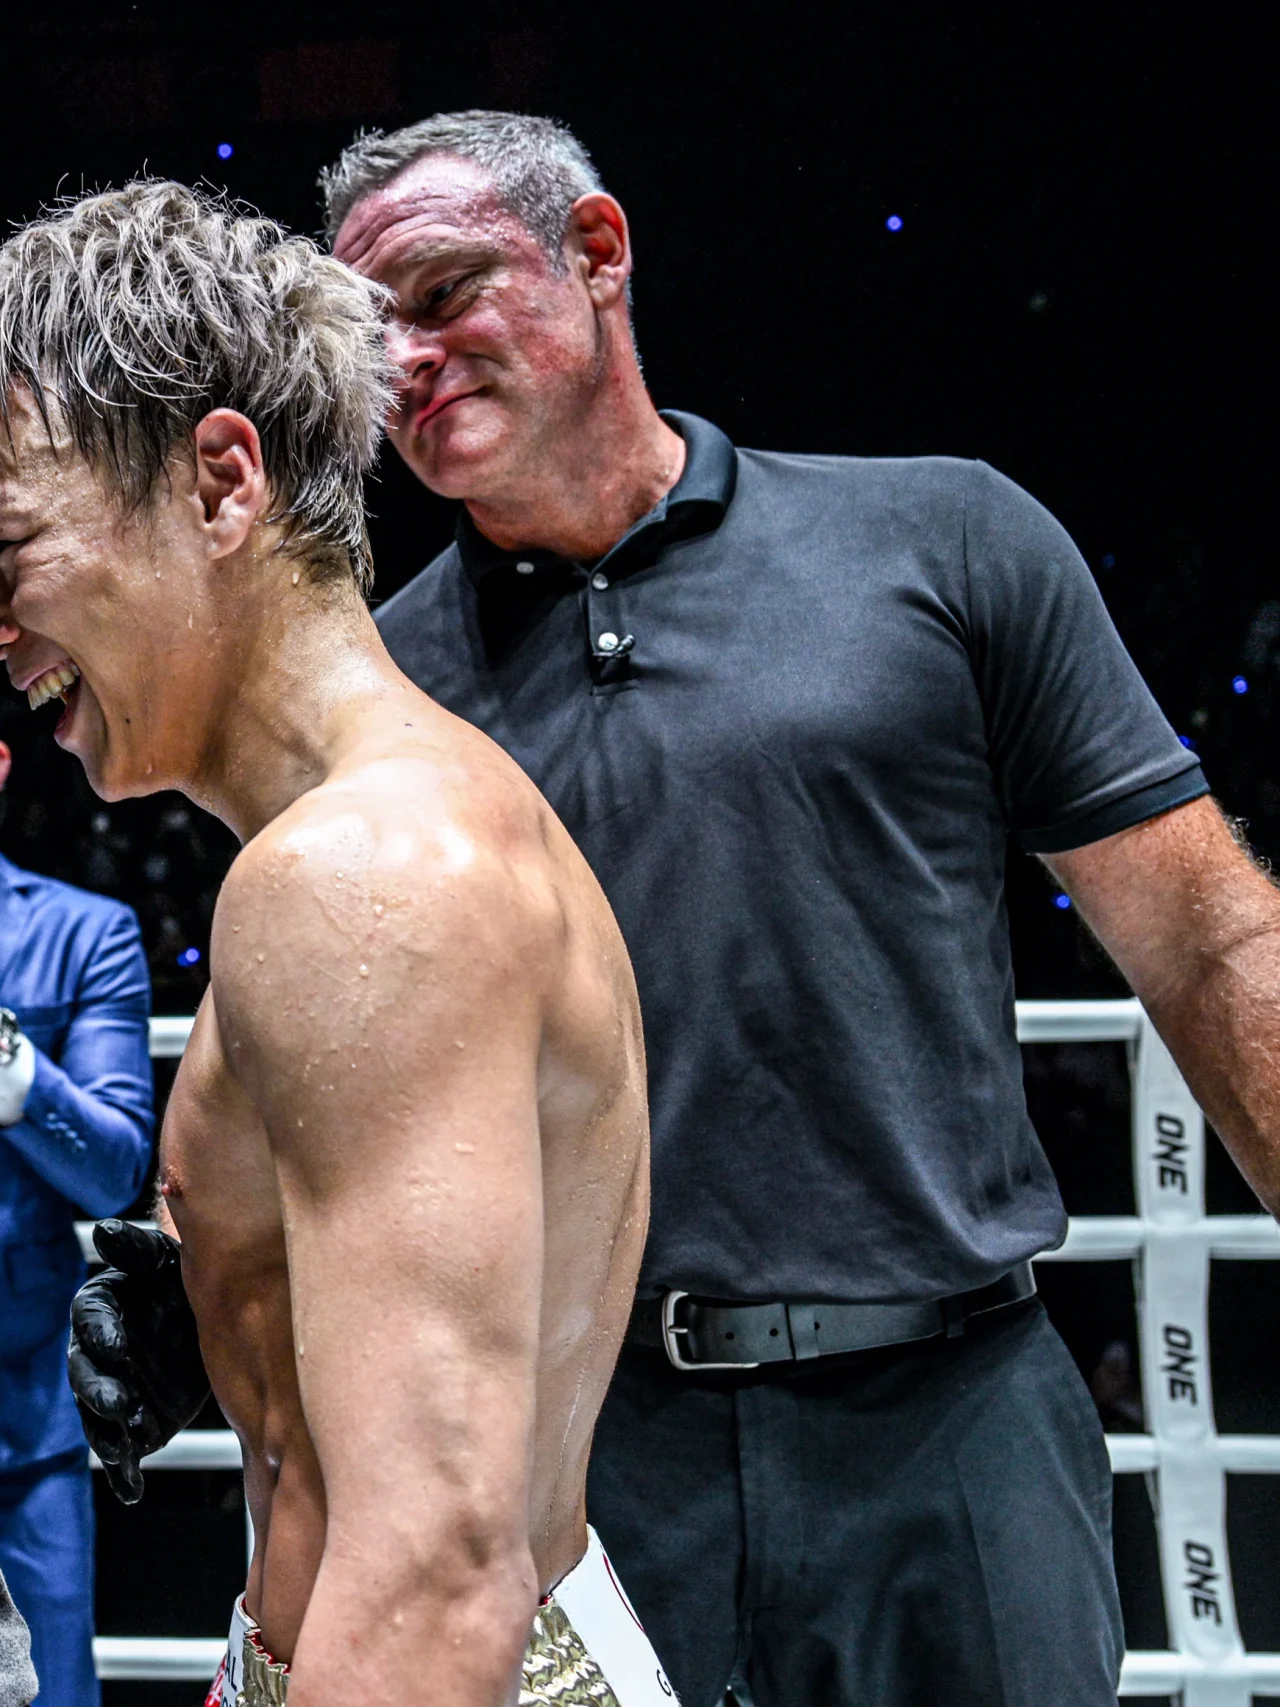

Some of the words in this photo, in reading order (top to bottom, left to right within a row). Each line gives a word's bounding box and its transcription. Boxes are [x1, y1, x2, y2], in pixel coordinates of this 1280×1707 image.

[1152, 1112, 1189, 1195] ONE
[1160, 1323, 1199, 1407] ONE
[1183, 1541, 1222, 1627] ONE
